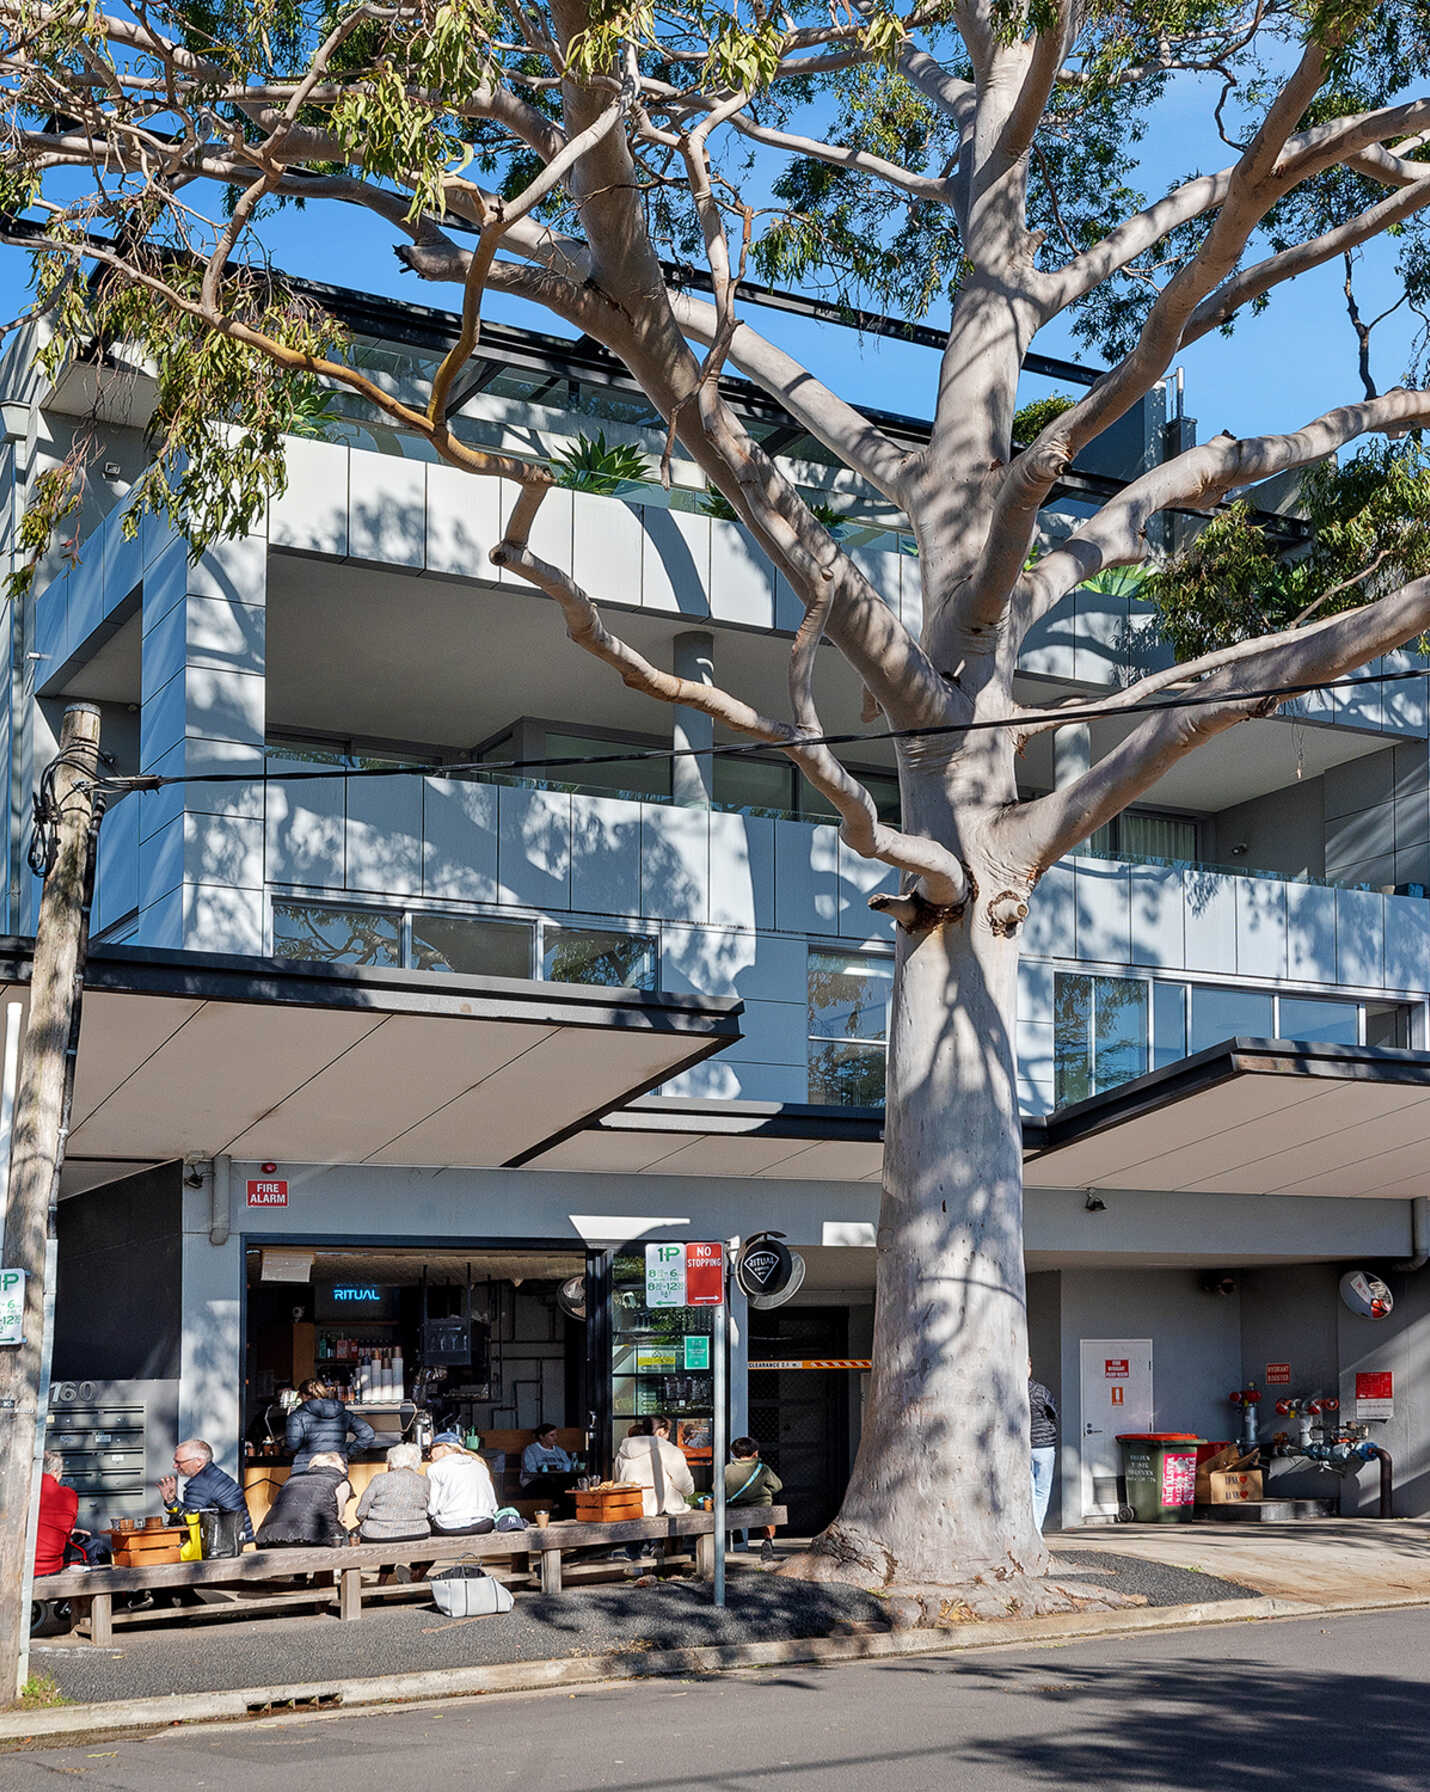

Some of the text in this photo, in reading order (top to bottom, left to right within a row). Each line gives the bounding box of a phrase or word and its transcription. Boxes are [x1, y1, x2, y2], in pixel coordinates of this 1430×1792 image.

[256, 1183, 280, 1193] FIRE
[250, 1193, 286, 1204] ALARM
[657, 1247, 680, 1262] 1P
[696, 1246, 712, 1257] NO
[687, 1258, 722, 1268] STOPPING
[0, 1272, 20, 1292] P
[333, 1288, 381, 1301] RITUAL
[49, 1380, 97, 1402] 160
